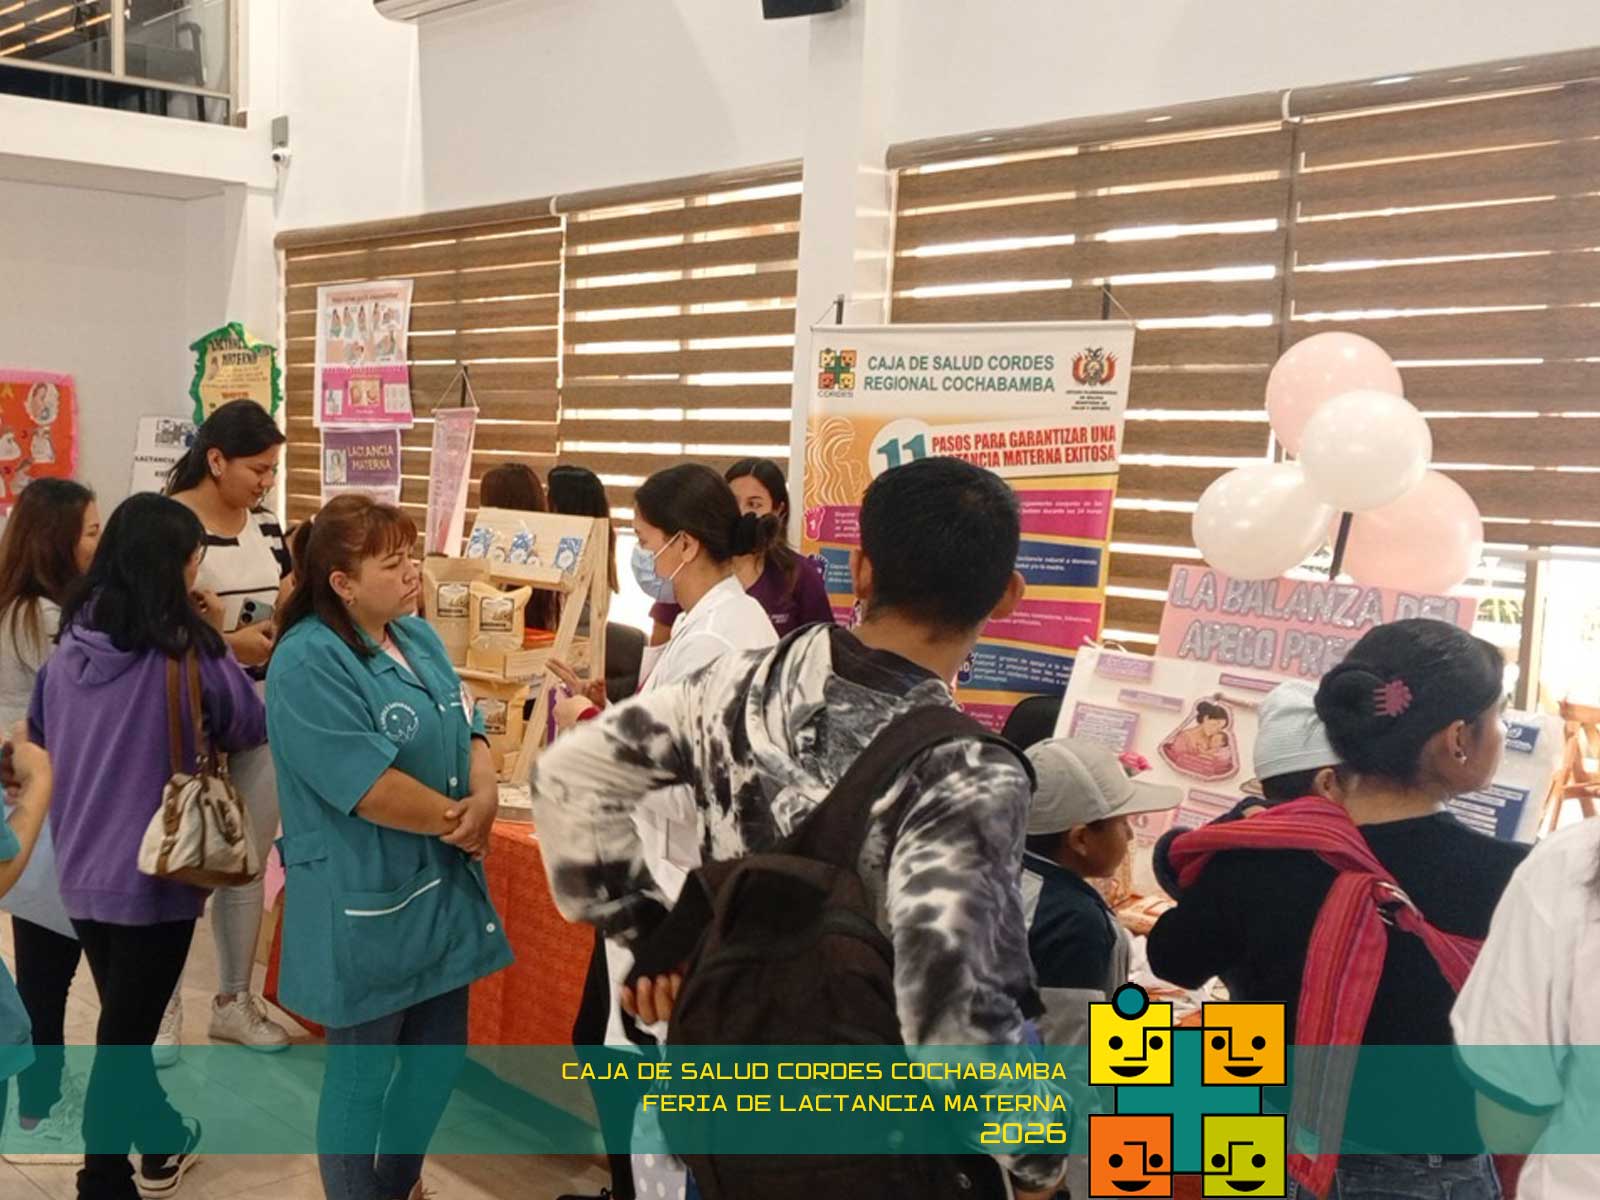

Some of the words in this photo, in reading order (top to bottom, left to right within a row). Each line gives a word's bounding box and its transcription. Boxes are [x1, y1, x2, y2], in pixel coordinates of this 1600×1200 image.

[867, 355, 906, 371] CAJA
[909, 355, 929, 371] DE
[932, 355, 984, 371] SALUD
[987, 355, 1055, 371] CORDES
[863, 376, 939, 391] REGIONAL
[942, 376, 1056, 392] COCHABAMBA
[931, 434, 972, 453] PASOS
[974, 431, 1007, 450] PARA
[1009, 427, 1088, 448] GARANTIZAR
[1091, 424, 1116, 443] UNA
[347, 444, 394, 457] LACTANCIA
[1003, 447, 1062, 467] MATERNA
[1064, 444, 1116, 463] EXITOSA
[351, 459, 392, 471] MATERNA
[1171, 568, 1218, 612] LA
[1222, 577, 1384, 630] BALANZA
[1178, 619, 1277, 670] APEGO
